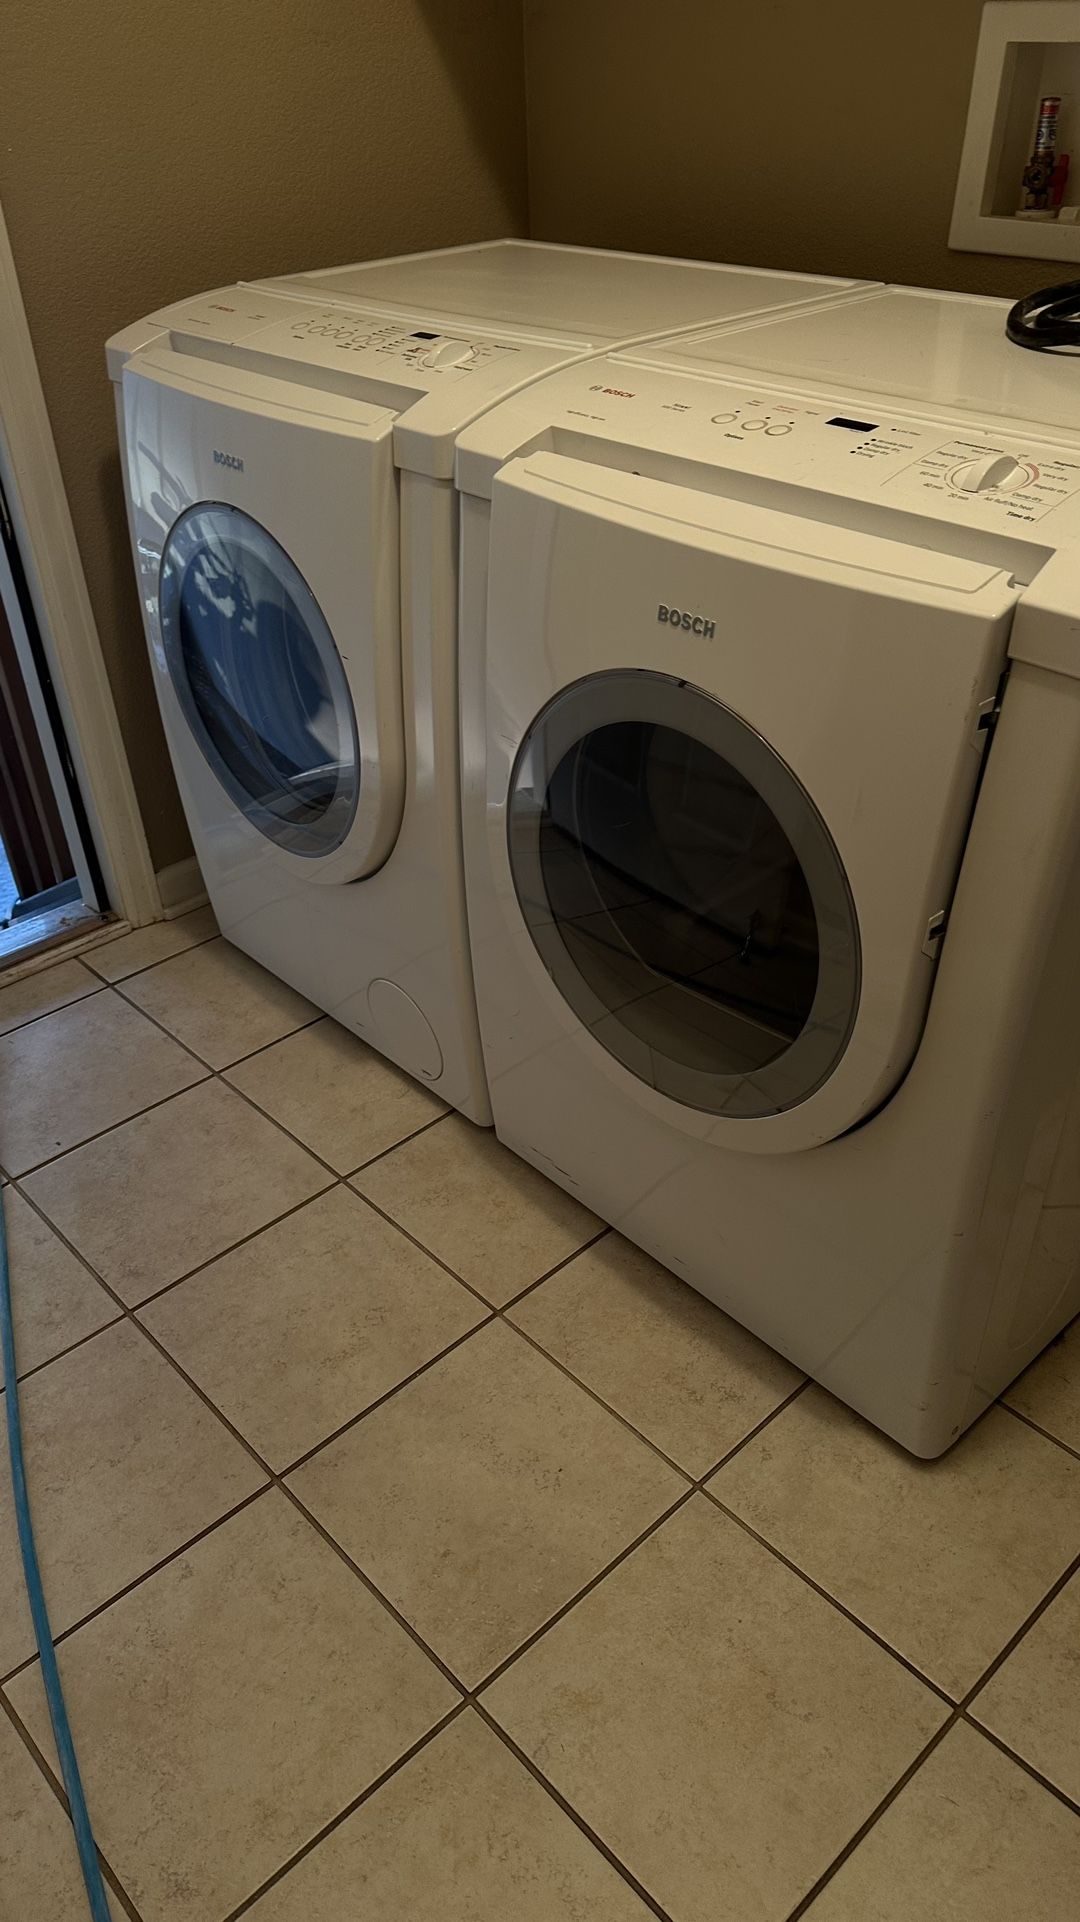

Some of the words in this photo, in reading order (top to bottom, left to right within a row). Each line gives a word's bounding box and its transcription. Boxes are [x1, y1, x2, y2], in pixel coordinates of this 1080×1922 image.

[602, 388, 636, 399] BOSCH
[212, 449, 245, 473] BOSCH
[1032, 483, 1057, 491] Regular
[1011, 491, 1032, 499] Damp
[1006, 510, 1024, 519] Time
[657, 603, 717, 639] BOSCH
